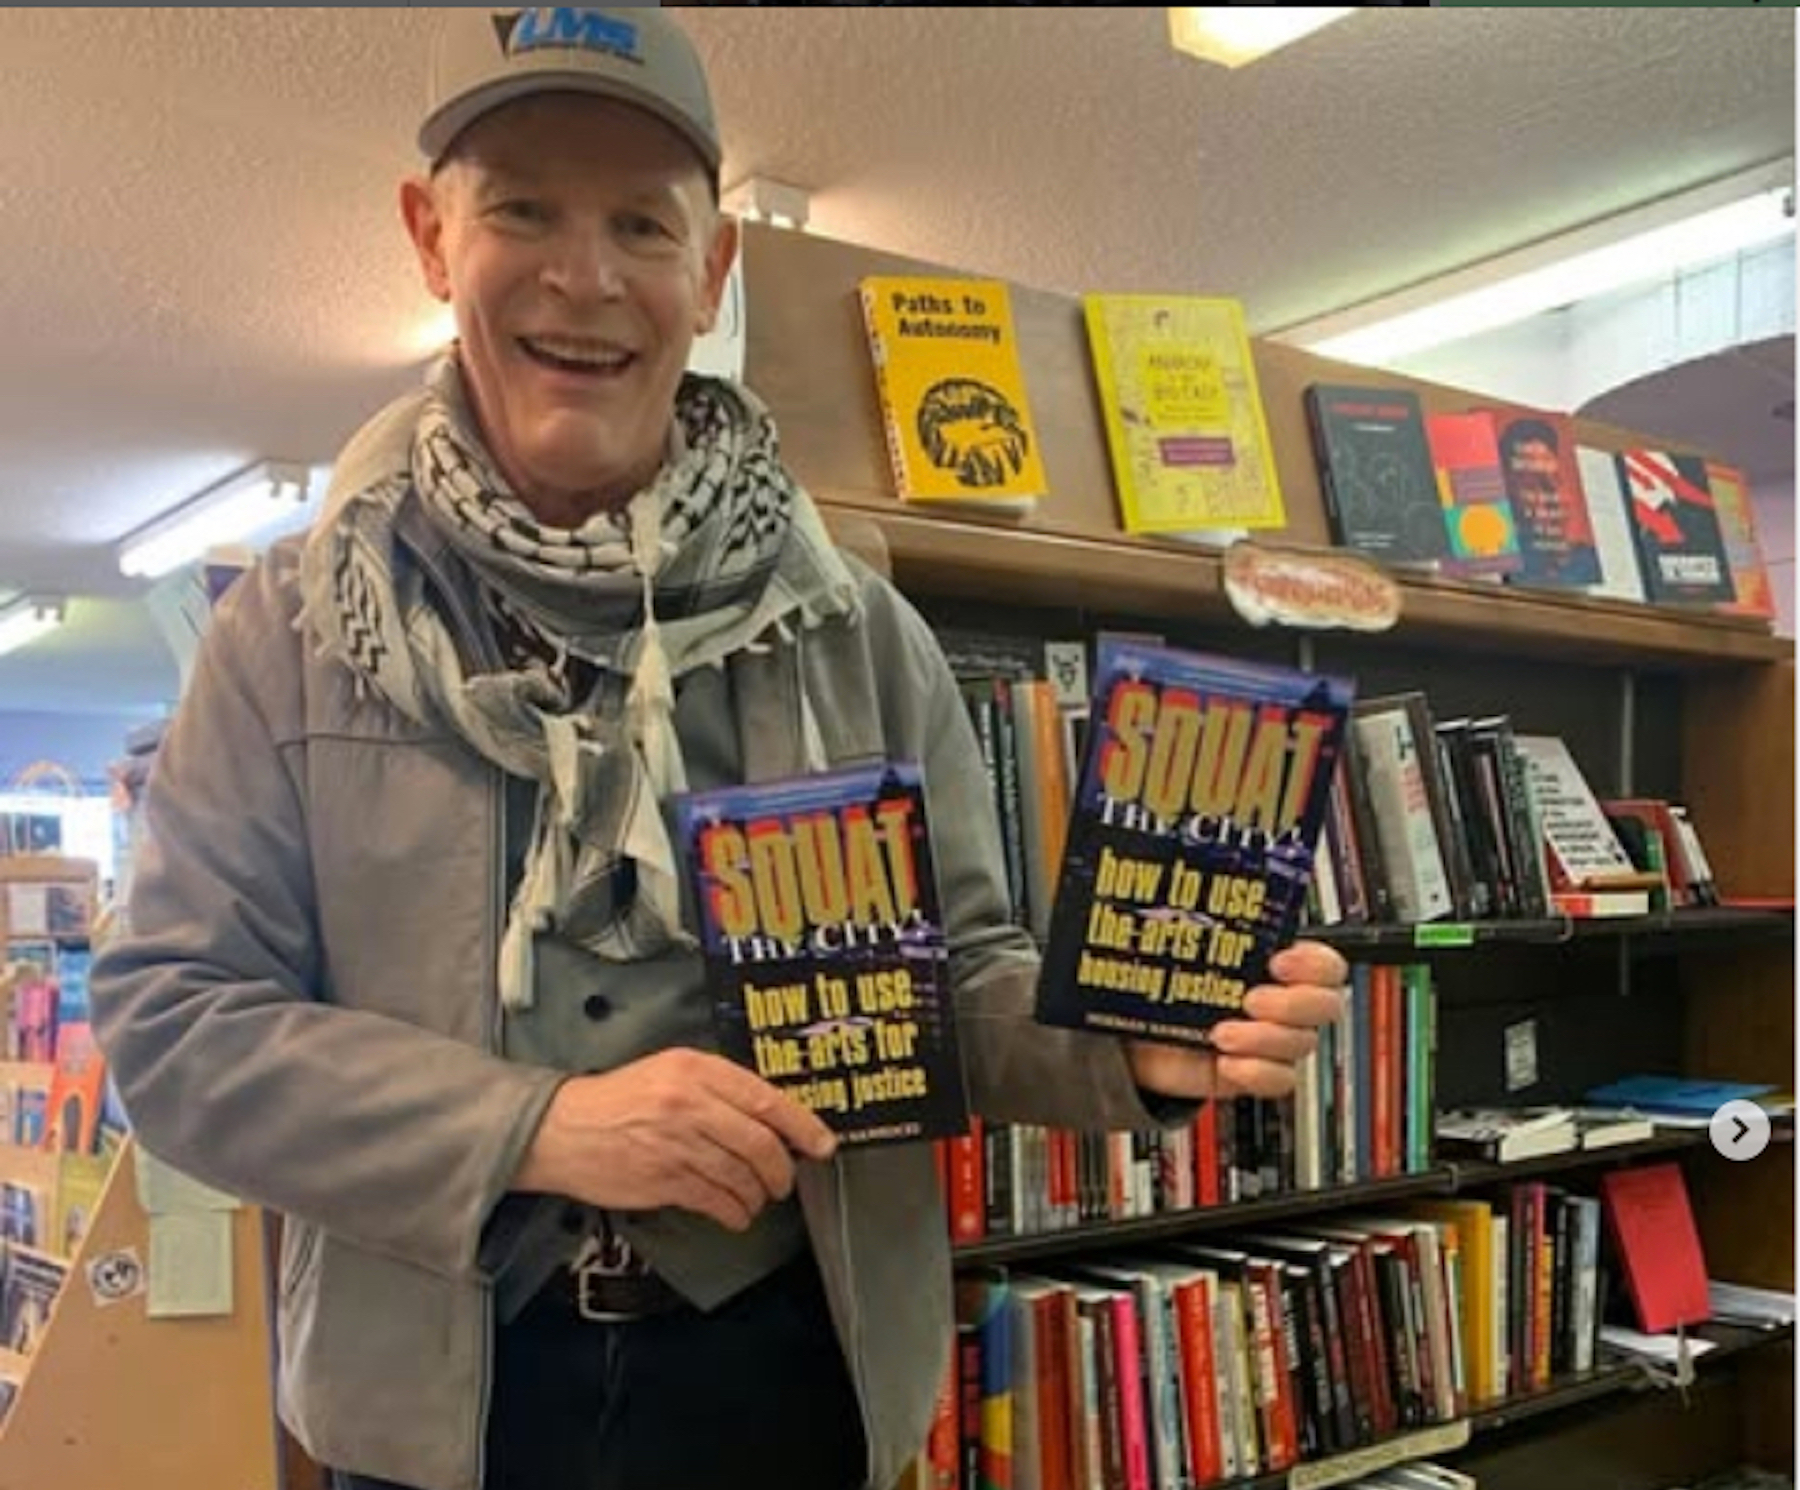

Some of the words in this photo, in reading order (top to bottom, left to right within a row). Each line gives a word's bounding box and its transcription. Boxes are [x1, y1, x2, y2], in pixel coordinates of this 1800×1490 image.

[890, 291, 954, 315] Paths
[962, 295, 986, 316] to
[898, 318, 1002, 344] Autonomy
[1100, 678, 1334, 830] SQUAT
[702, 797, 918, 949] SQUAT
[1096, 846, 1162, 901] how
[1168, 858, 1202, 911] to
[1209, 873, 1266, 921] use
[1087, 901, 1134, 950] the
[1140, 916, 1203, 960] arts
[1206, 922, 1254, 968] for
[743, 981, 807, 1030] how
[815, 971, 849, 1018] to
[859, 967, 912, 1015] use
[1076, 949, 1165, 1002] housing
[1163, 964, 1246, 1010] justice
[754, 1034, 801, 1077] the
[809, 1026, 869, 1069] arts
[873, 1018, 919, 1061] for
[783, 1073, 849, 1113] using
[852, 1065, 927, 1111] justice
